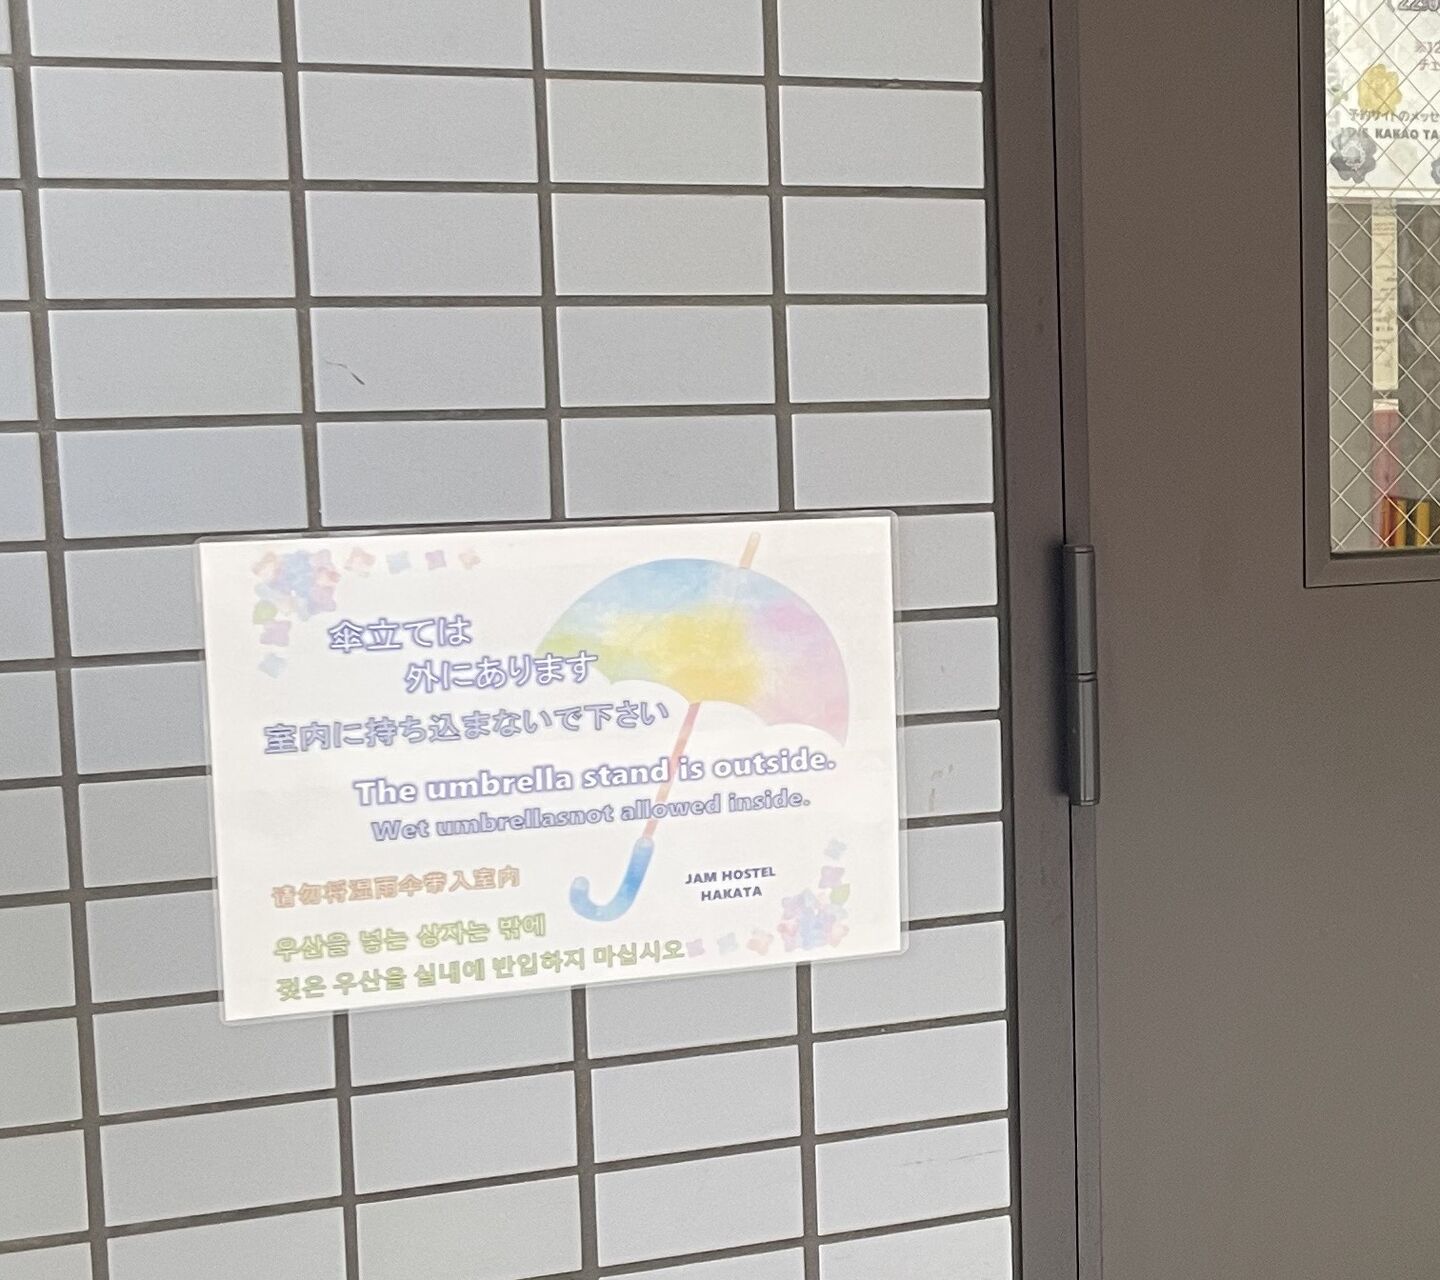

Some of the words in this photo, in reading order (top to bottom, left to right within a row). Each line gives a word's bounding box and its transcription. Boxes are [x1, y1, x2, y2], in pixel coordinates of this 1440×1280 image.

[329, 614, 472, 654] 傘立ては
[405, 650, 599, 694] 外にあります
[263, 699, 670, 756] 室内に持ち込まないで下さい
[354, 779, 417, 808] The
[427, 764, 574, 803] umbrella
[582, 756, 671, 790] stand
[679, 754, 703, 781] is
[713, 747, 836, 778] outside.
[371, 818, 429, 842] Wet
[436, 803, 615, 839] umbrellasnot
[622, 793, 722, 825] allowed
[728, 787, 812, 813] inside.
[685, 869, 718, 885] JAM
[720, 865, 776, 883] HOSTEL
[700, 885, 763, 902] HAKATA
[273, 931, 350, 963] 우산을
[416, 919, 491, 950] 상자는
[332, 966, 407, 997] 우산을
[413, 957, 485, 988] 실내에
[491, 948, 586, 981] 반입하지
[593, 938, 687, 969] 마십시오
